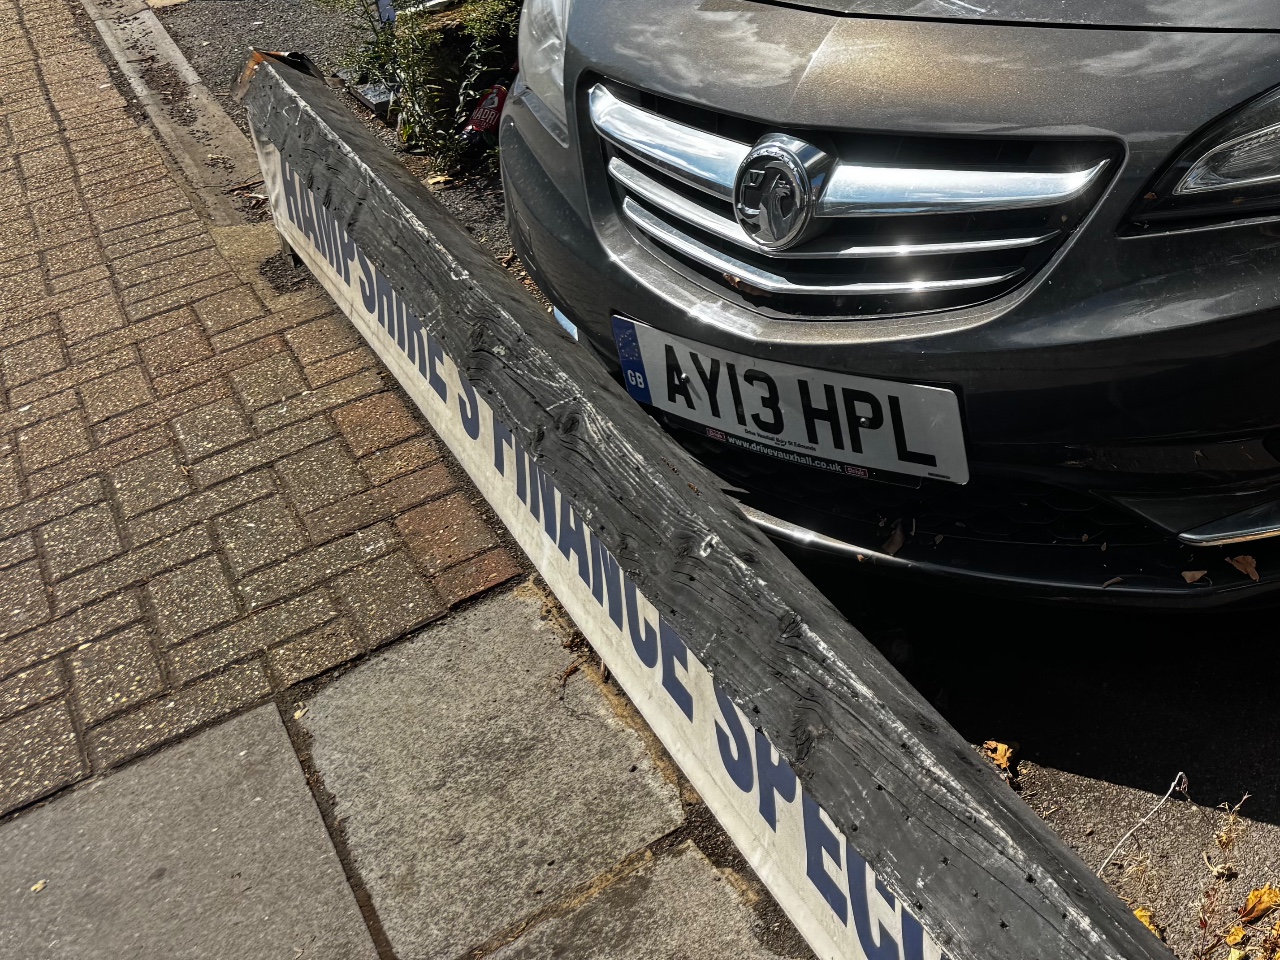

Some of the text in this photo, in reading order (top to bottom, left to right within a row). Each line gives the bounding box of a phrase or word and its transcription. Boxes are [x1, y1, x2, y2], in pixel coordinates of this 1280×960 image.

[627, 369, 645, 389] GB
[664, 343, 938, 467] AY13 HPL
[727, 435, 842, 472] www.drivevauxhall.co.uk
